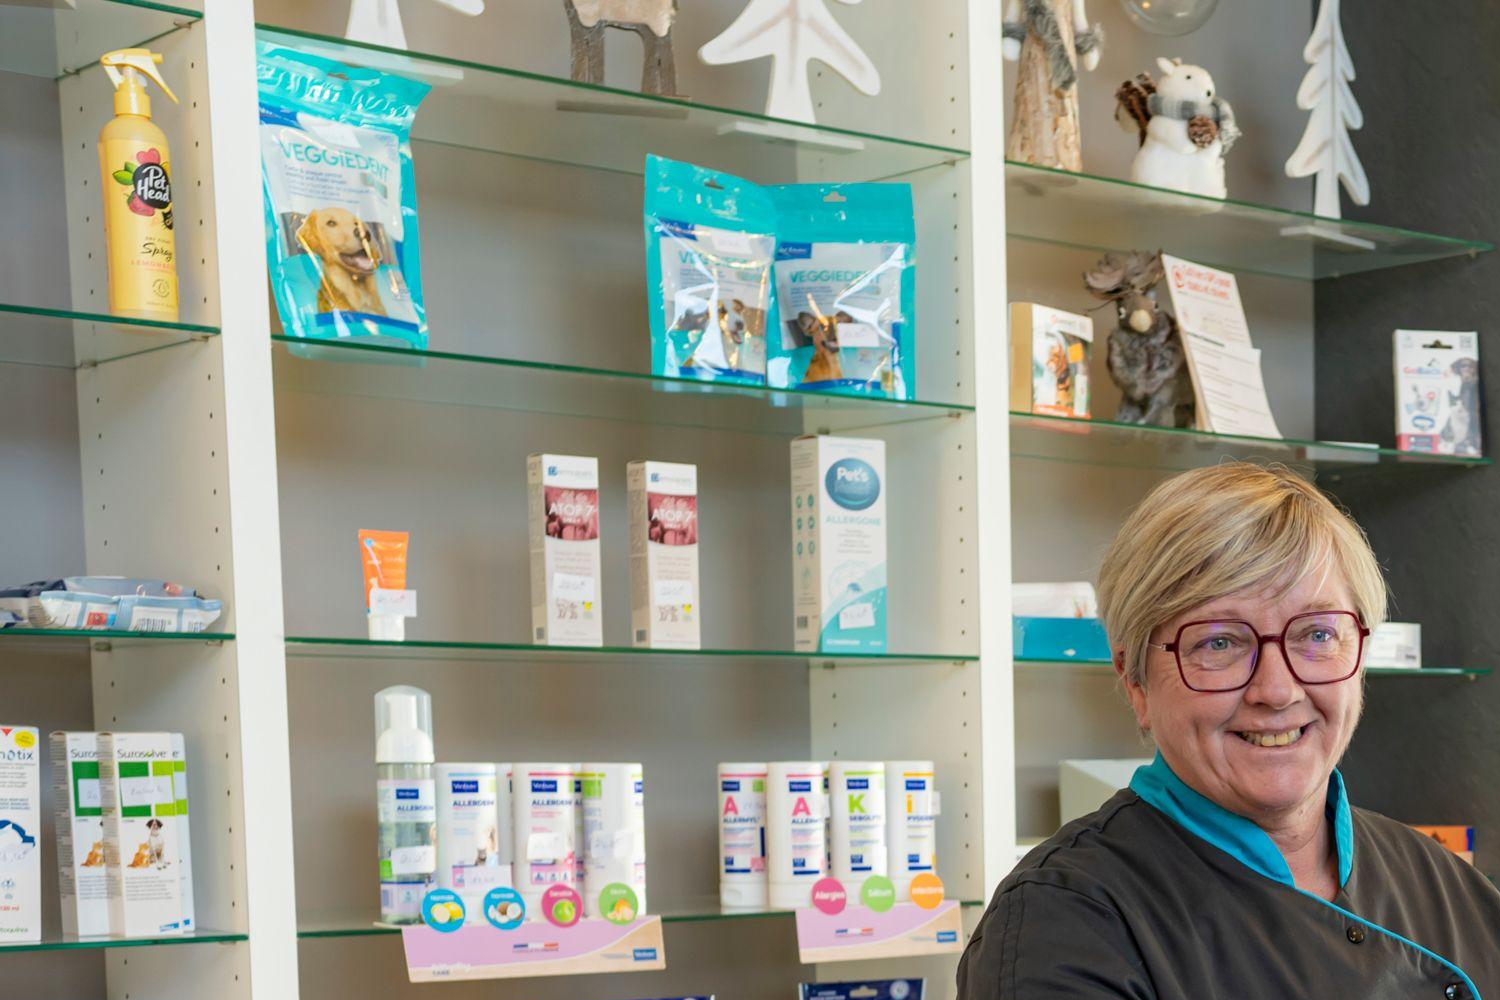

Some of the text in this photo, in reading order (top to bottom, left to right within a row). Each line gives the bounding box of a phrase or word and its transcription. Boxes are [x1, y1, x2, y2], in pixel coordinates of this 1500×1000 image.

[142, 165, 167, 190] Pet
[136, 176, 171, 203] Head
[140, 242, 173, 262] Spray
[723, 795, 739, 816] A
[792, 796, 811, 817] A
[848, 793, 866, 814] K
